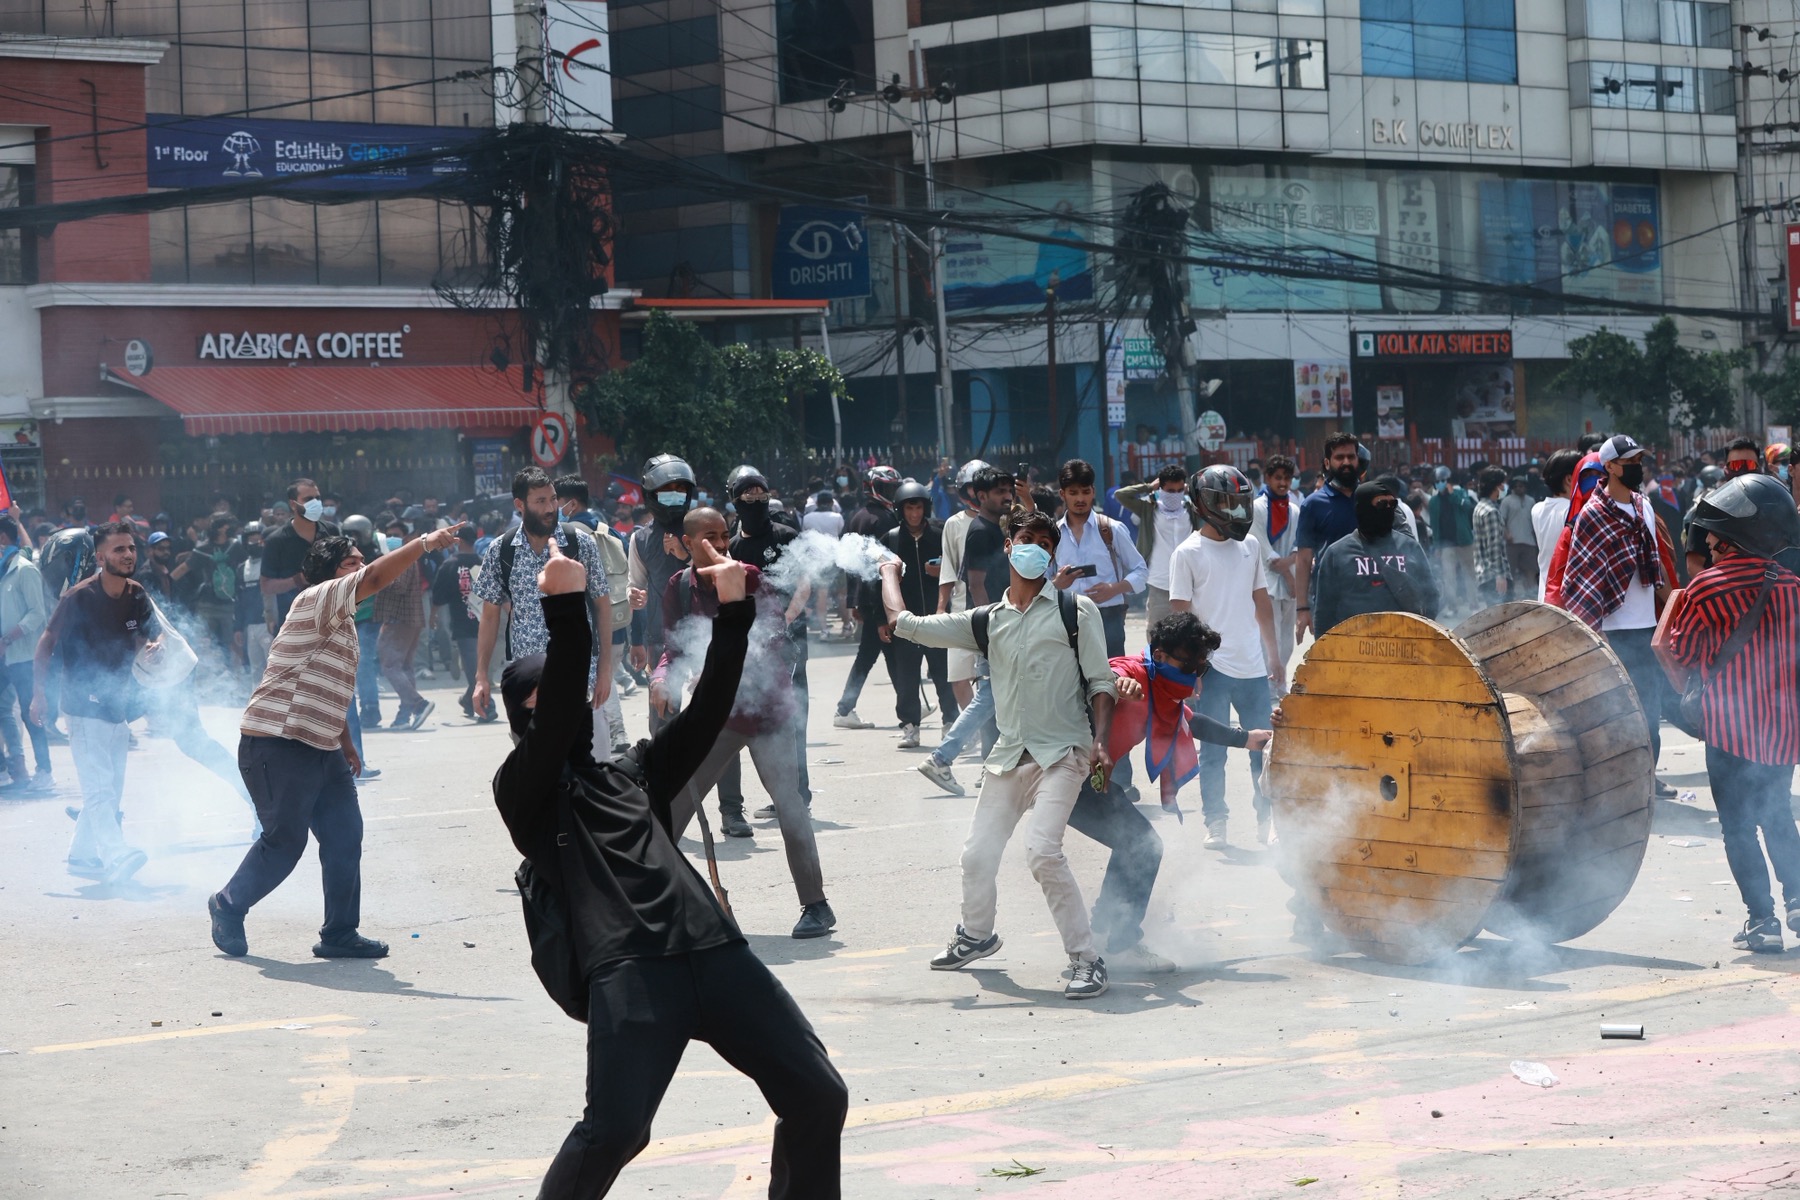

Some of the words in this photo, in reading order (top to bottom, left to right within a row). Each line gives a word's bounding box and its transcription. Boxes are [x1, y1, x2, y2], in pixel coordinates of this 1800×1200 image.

[1372, 118, 1408, 146] B.K
[1420, 120, 1514, 150] COMPLEX
[155, 146, 170, 160] 1st
[173, 146, 209, 161] Floor
[275, 140, 344, 161] EduHub
[276, 162, 325, 173] EDUCATION
[1274, 203, 1308, 229] EYE
[1311, 204, 1378, 230] CENTER
[1614, 203, 1652, 214] DIABETES
[790, 262, 852, 285] DRISHTI
[200, 331, 312, 359] ARABICA
[316, 332, 404, 359] COFFEE
[1125, 340, 1145, 352] IELTS
[1377, 333, 1447, 354] KOLKATA
[1449, 333, 1510, 353] SWEETS
